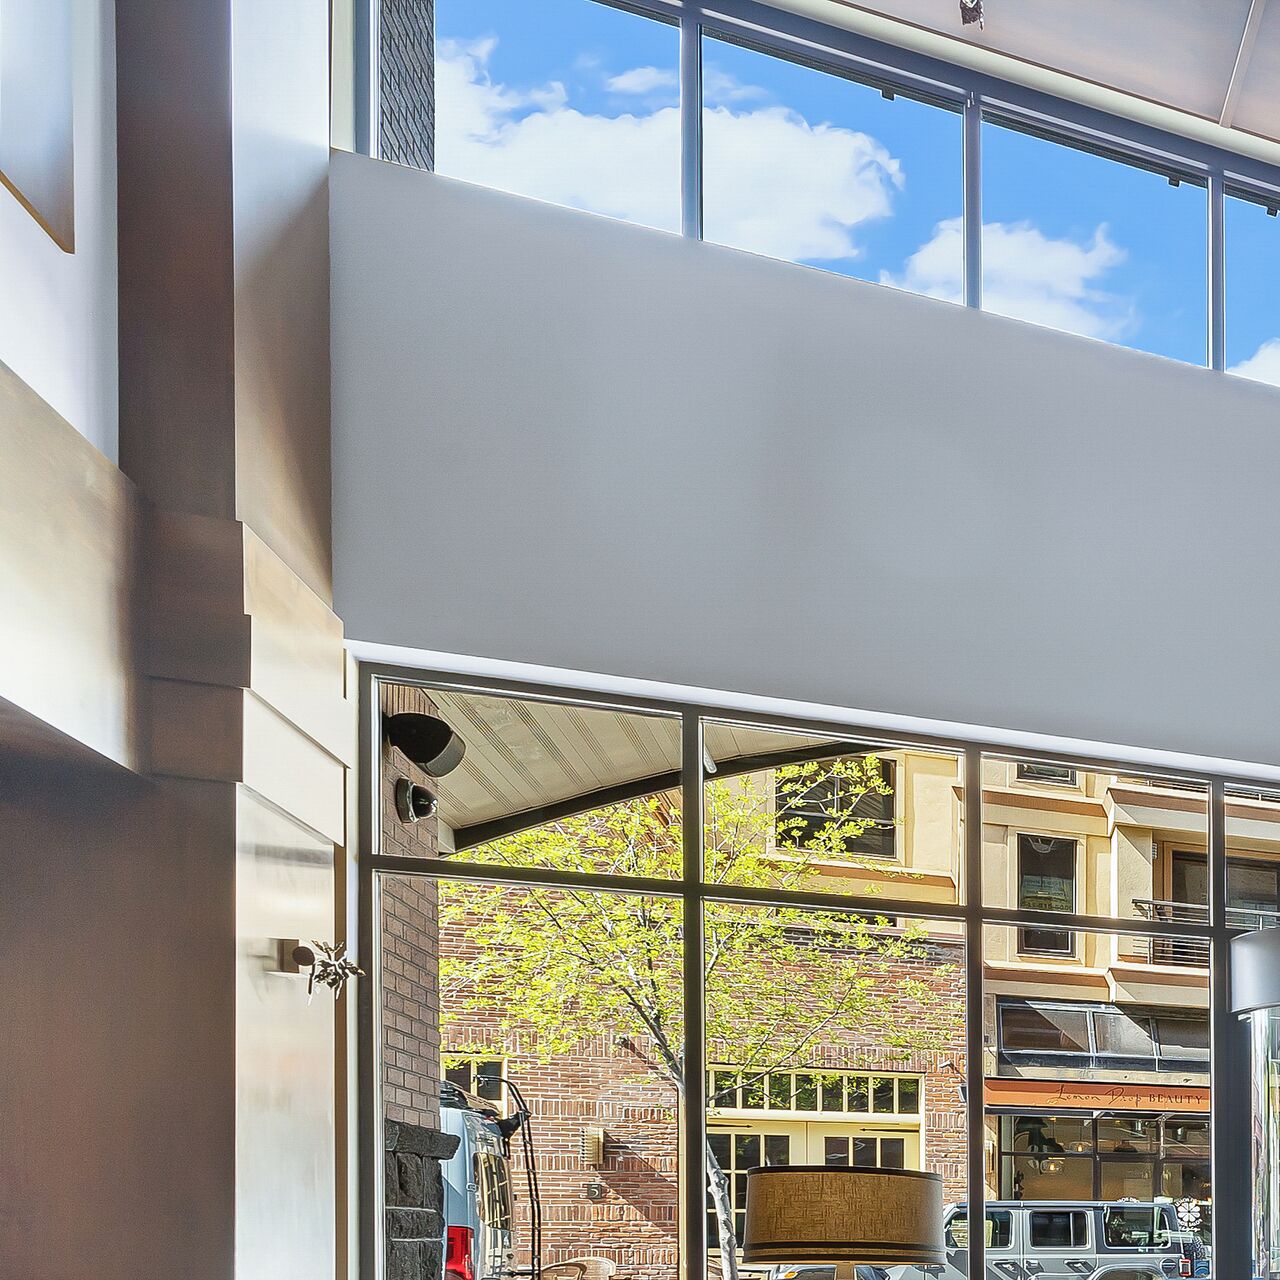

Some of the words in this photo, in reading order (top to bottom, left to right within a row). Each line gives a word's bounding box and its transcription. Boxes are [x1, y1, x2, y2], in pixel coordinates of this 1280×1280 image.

[1048, 1084, 1101, 1104] Lemon
[1105, 1086, 1142, 1108] Drop
[1149, 1093, 1204, 1105] BEAUTY
[590, 1184, 599, 1198] 5
